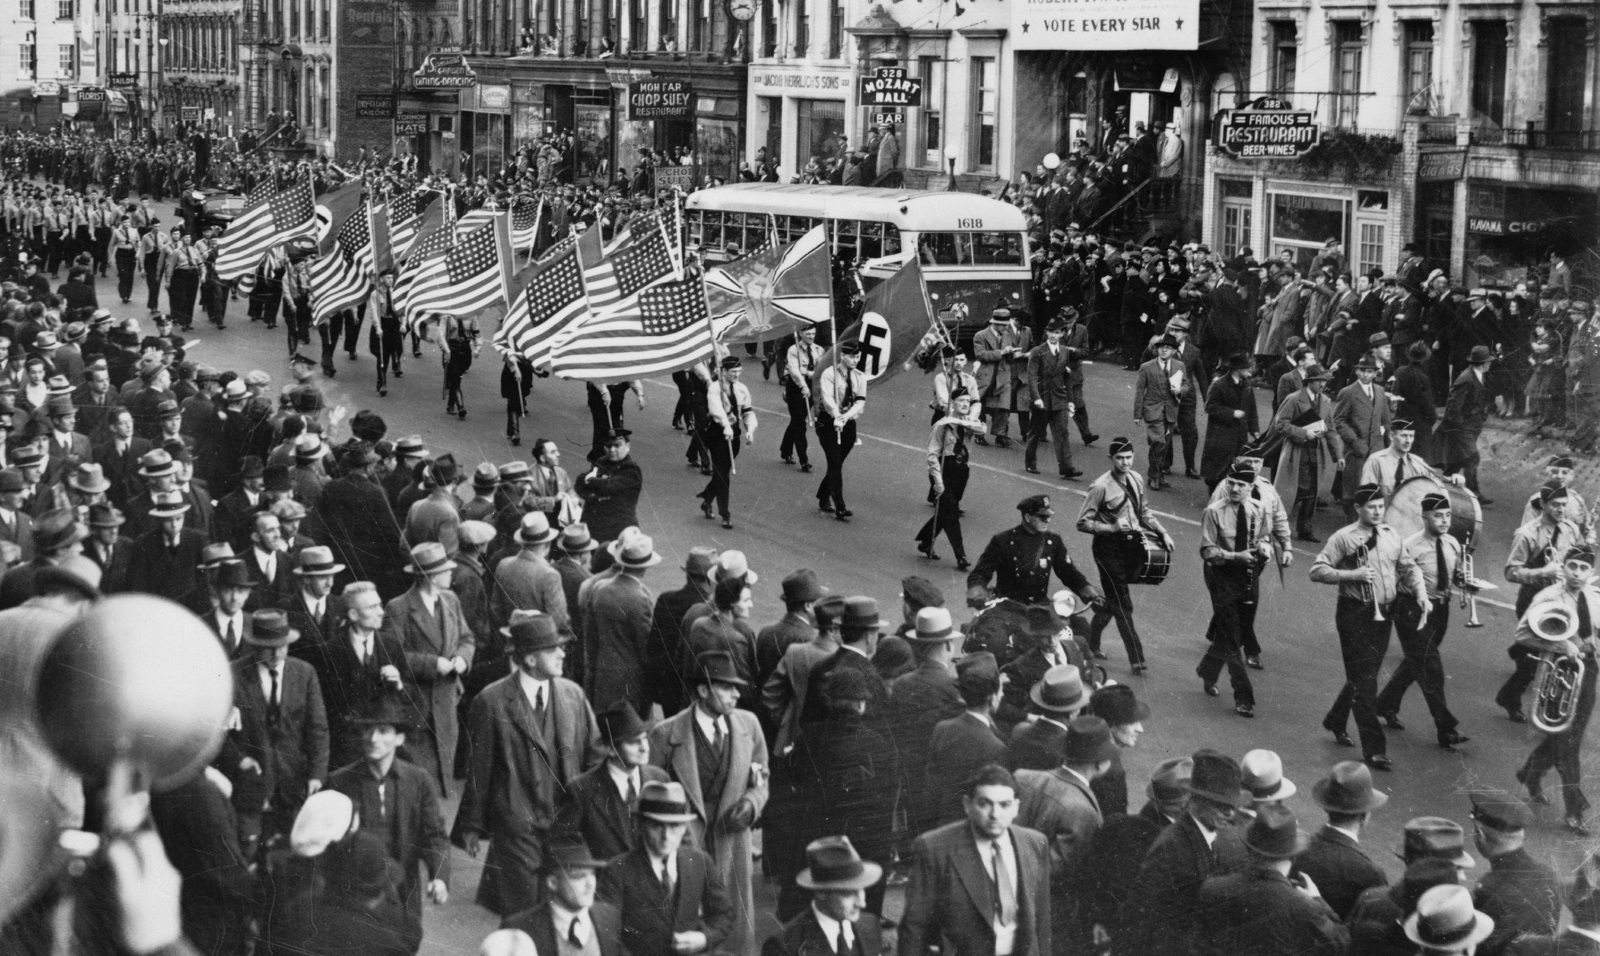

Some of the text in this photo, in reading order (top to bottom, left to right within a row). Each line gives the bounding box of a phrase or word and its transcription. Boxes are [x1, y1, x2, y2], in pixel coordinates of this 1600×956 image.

[348, 8, 393, 23] Rentals
[1044, 17, 1161, 32] VOTE EVERY STAR
[882, 69, 902, 78] 328
[763, 74, 783, 87] JACOB
[821, 76, 840, 89] SONS
[865, 78, 920, 94] MOZART
[662, 83, 682, 92] FAR
[78, 91, 105, 101] FLORIST
[632, 93, 690, 106] CHOP SUEY
[875, 92, 908, 103] HALL
[636, 107, 687, 116] RESTAURANT
[876, 113, 902, 124] BAR
[1249, 114, 1294, 125] FAMOUS
[396, 123, 427, 134] HATS
[1226, 126, 1315, 143] RESTAURANT
[1243, 144, 1295, 155] BEER-WINES
[1420, 164, 1461, 177] CIGARS
[658, 176, 693, 185] SUEY
[957, 218, 983, 229] 1618
[1470, 218, 1503, 233] HAVANA
